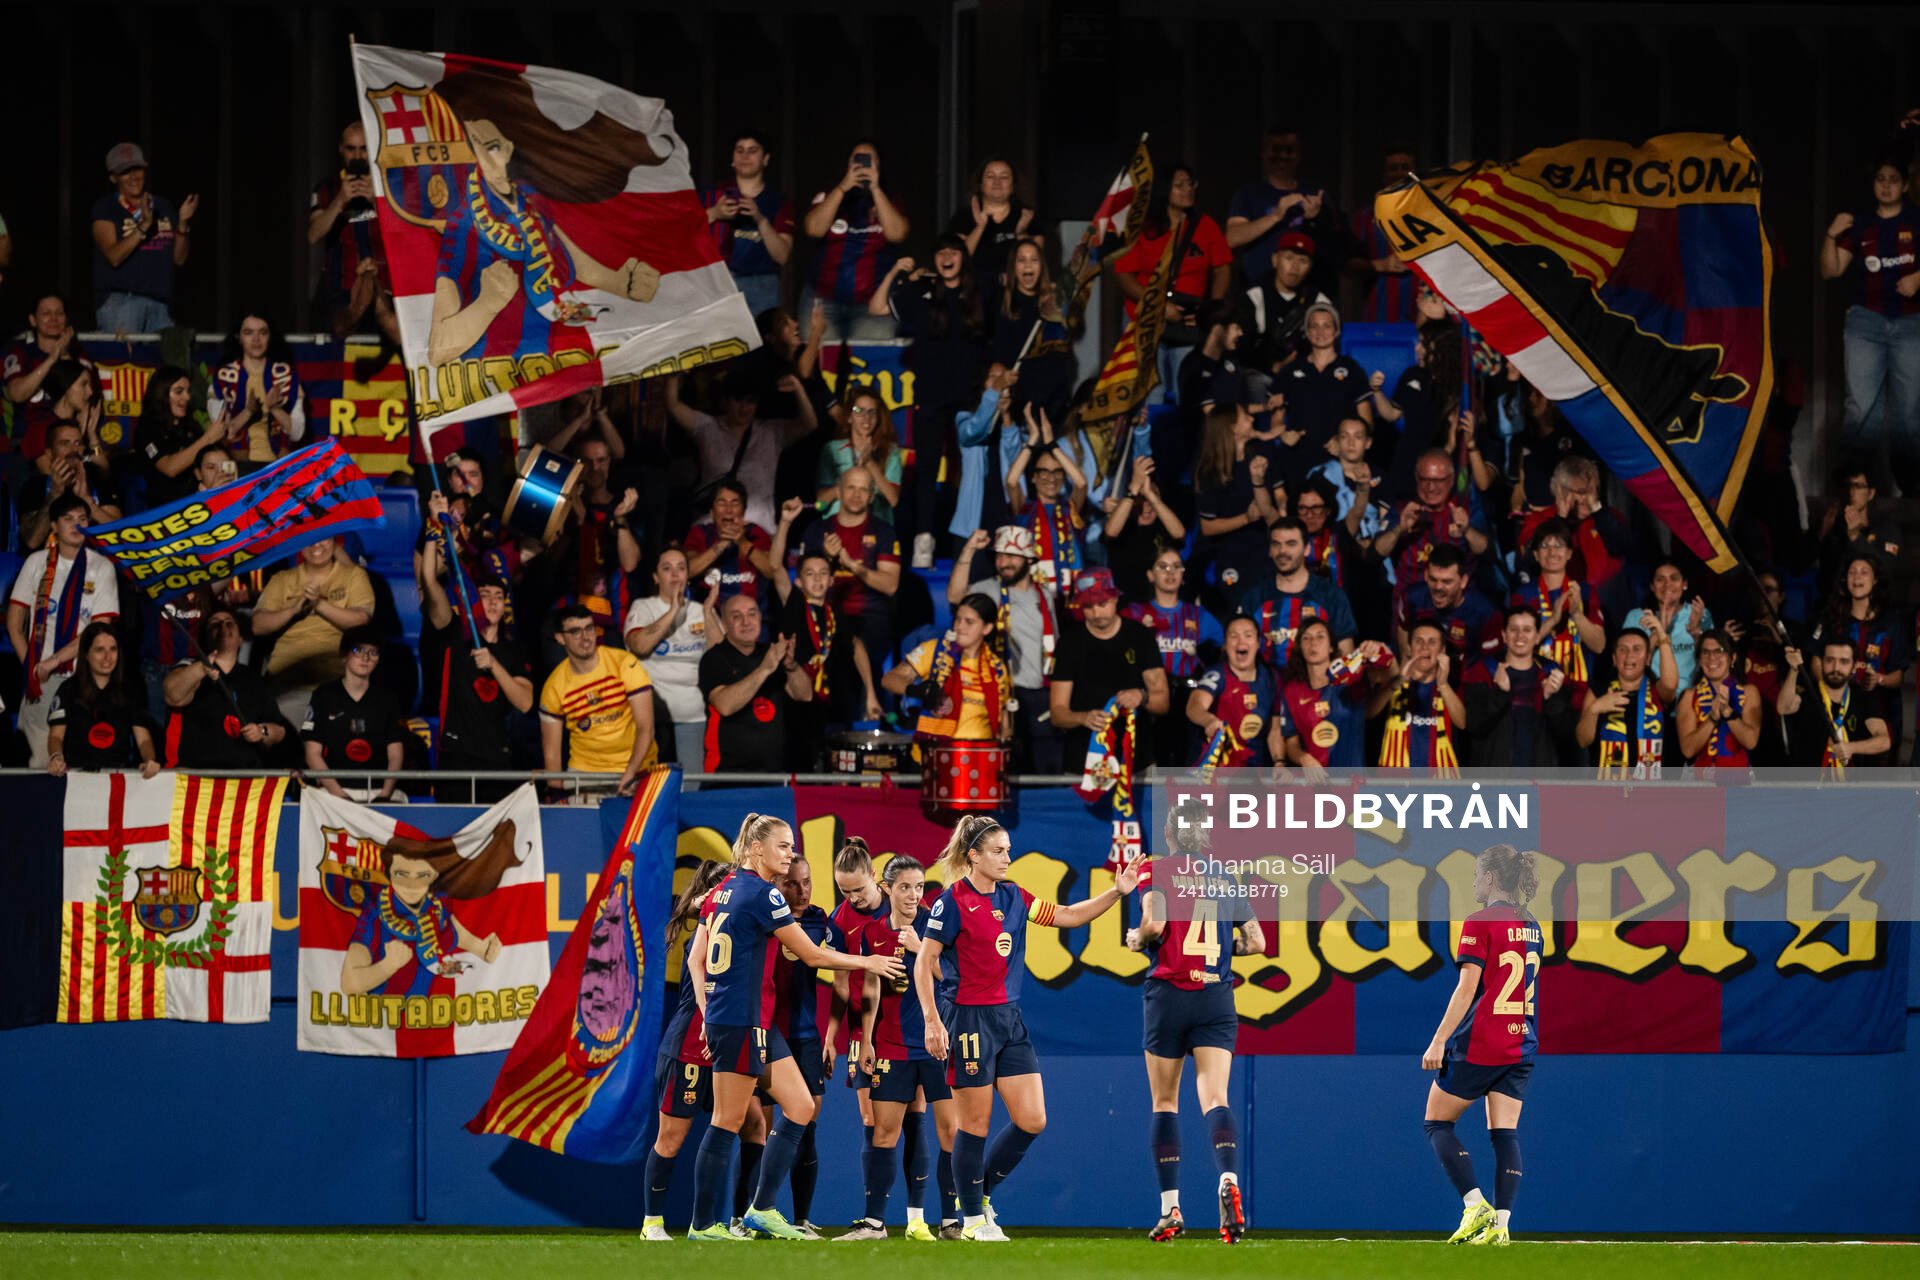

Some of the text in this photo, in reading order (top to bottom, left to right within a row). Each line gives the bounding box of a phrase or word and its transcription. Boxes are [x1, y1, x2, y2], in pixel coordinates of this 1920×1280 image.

[412, 145, 450, 163] FCB
[95, 503, 211, 545] TOTES
[114, 522, 238, 560] UNIDES
[130, 554, 200, 580] FEM
[146, 550, 255, 599] FORÇA
[722, 571, 756, 584] Spotify
[705, 911, 734, 975] 16
[1183, 899, 1221, 967] 4
[1492, 950, 1541, 1016] 22
[310, 983, 540, 1029] LLUITADORES
[958, 1033, 980, 1059] 11
[684, 1065, 699, 1089] 9
